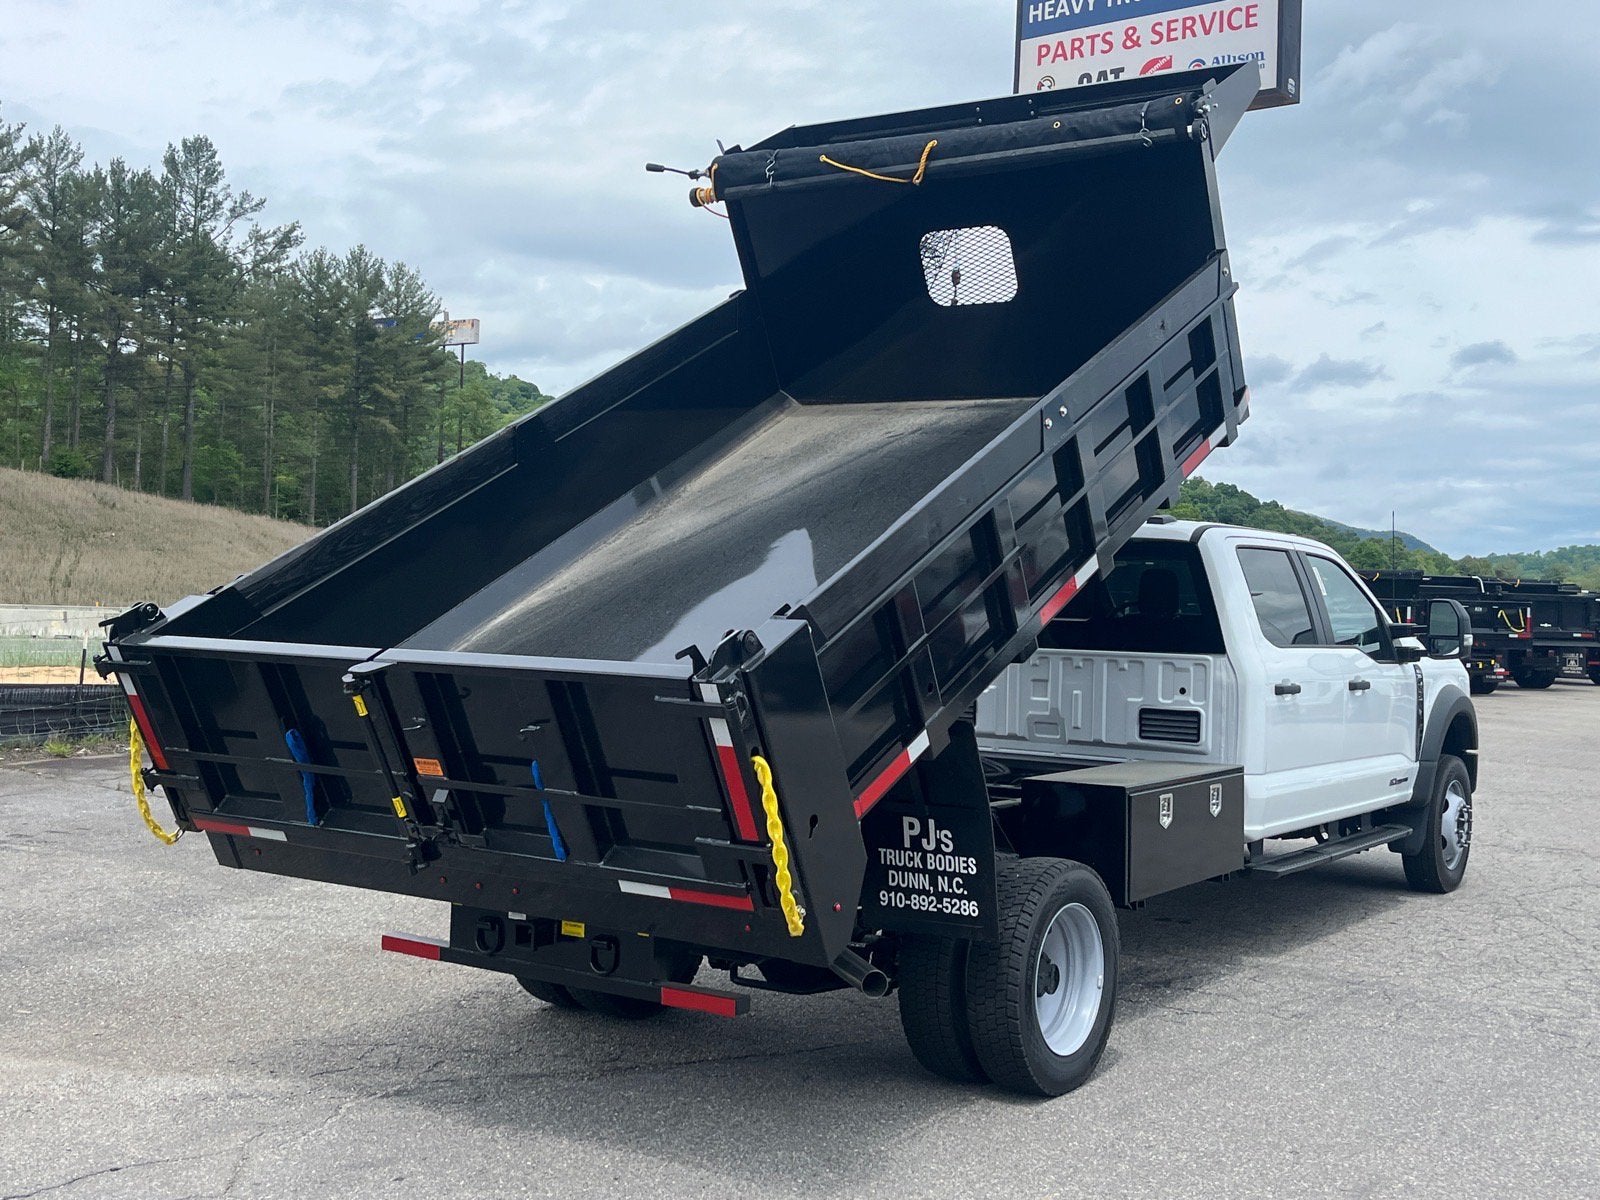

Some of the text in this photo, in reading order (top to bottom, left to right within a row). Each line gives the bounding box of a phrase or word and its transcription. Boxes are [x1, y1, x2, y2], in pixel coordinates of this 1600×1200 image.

[1028, 0, 1096, 23] HEAVY
[1036, 4, 1259, 66] PARTS & SERVICE
[878, 847, 977, 875] TRUCK BODIES
[888, 869, 968, 895] DUNN, N.C.
[879, 890, 979, 917] 910-892-5286
